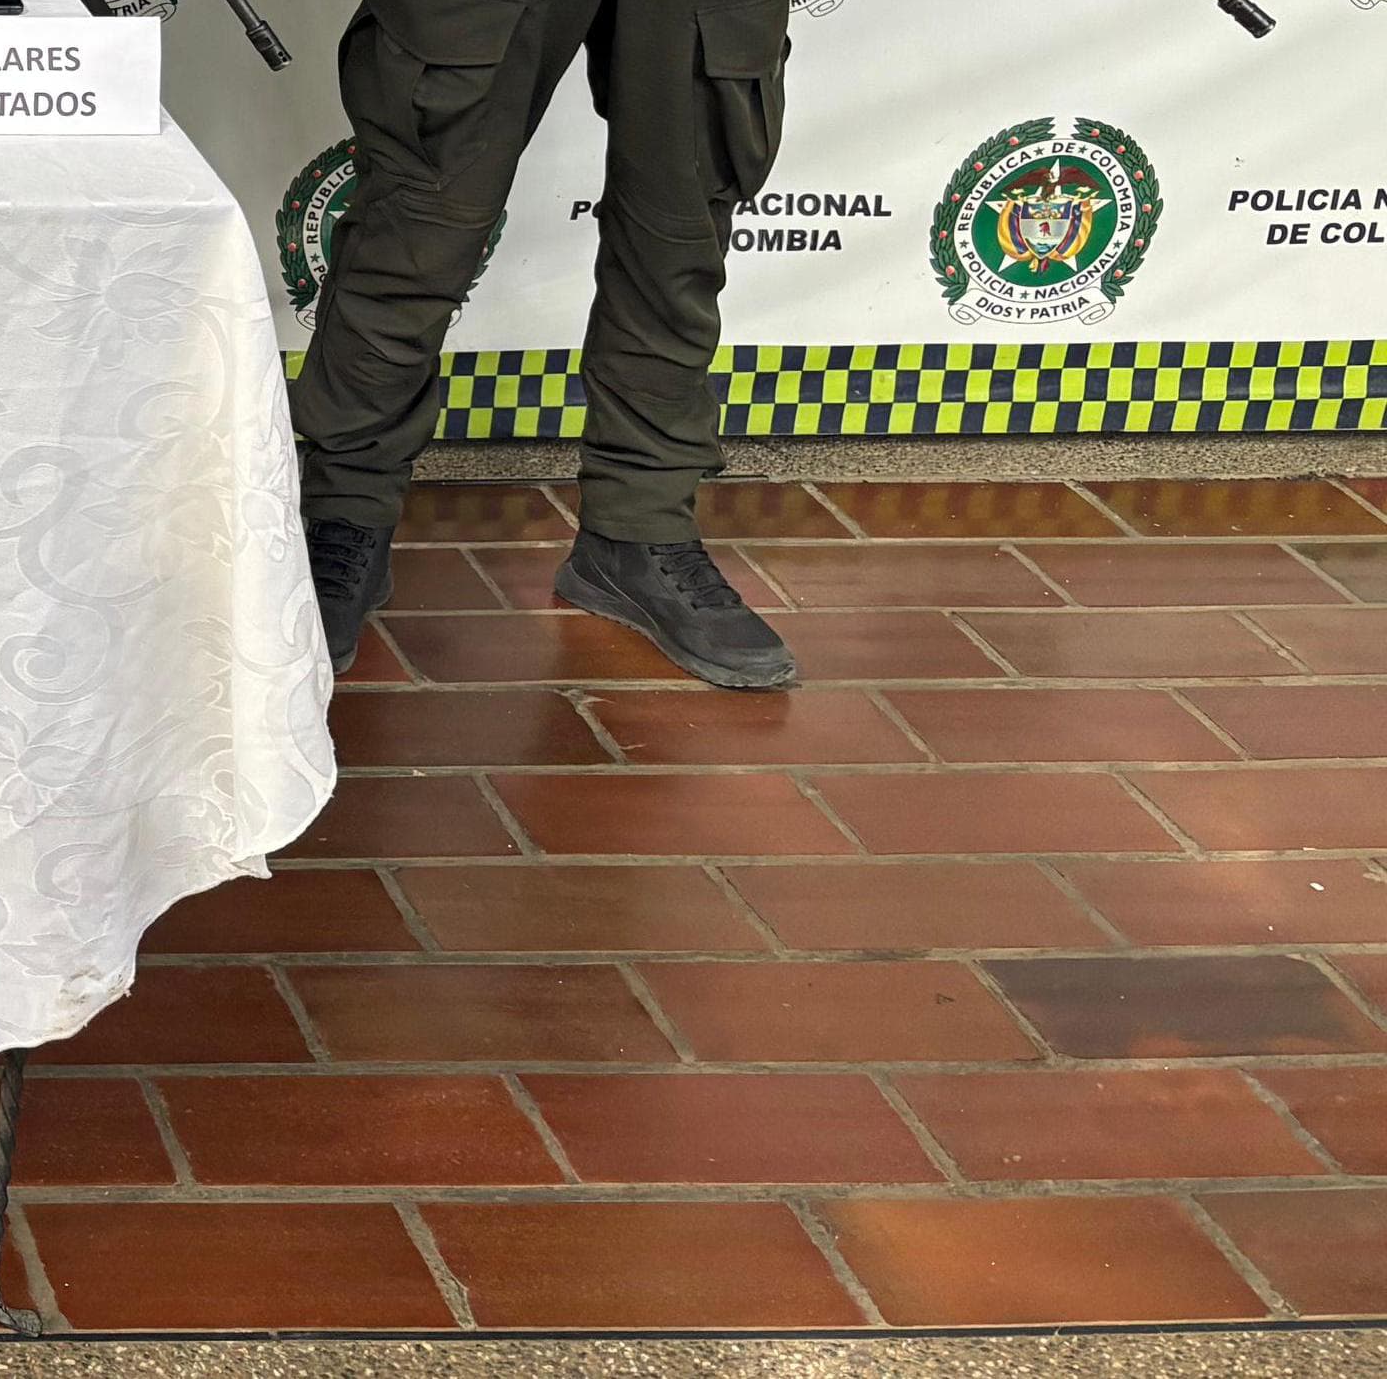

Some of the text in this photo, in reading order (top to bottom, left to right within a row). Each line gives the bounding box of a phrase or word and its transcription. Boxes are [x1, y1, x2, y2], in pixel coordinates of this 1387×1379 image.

[1051, 142, 1077, 154] DE
[1088, 148, 1132, 231] COLOMBIA
[736, 193, 891, 215] ACIONAL
[1228, 189, 1361, 211] POLICIA
[1267, 223, 1310, 244] DE
[1035, 250, 1118, 300] NACIONAL
[1031, 297, 1090, 319] PATRIA
